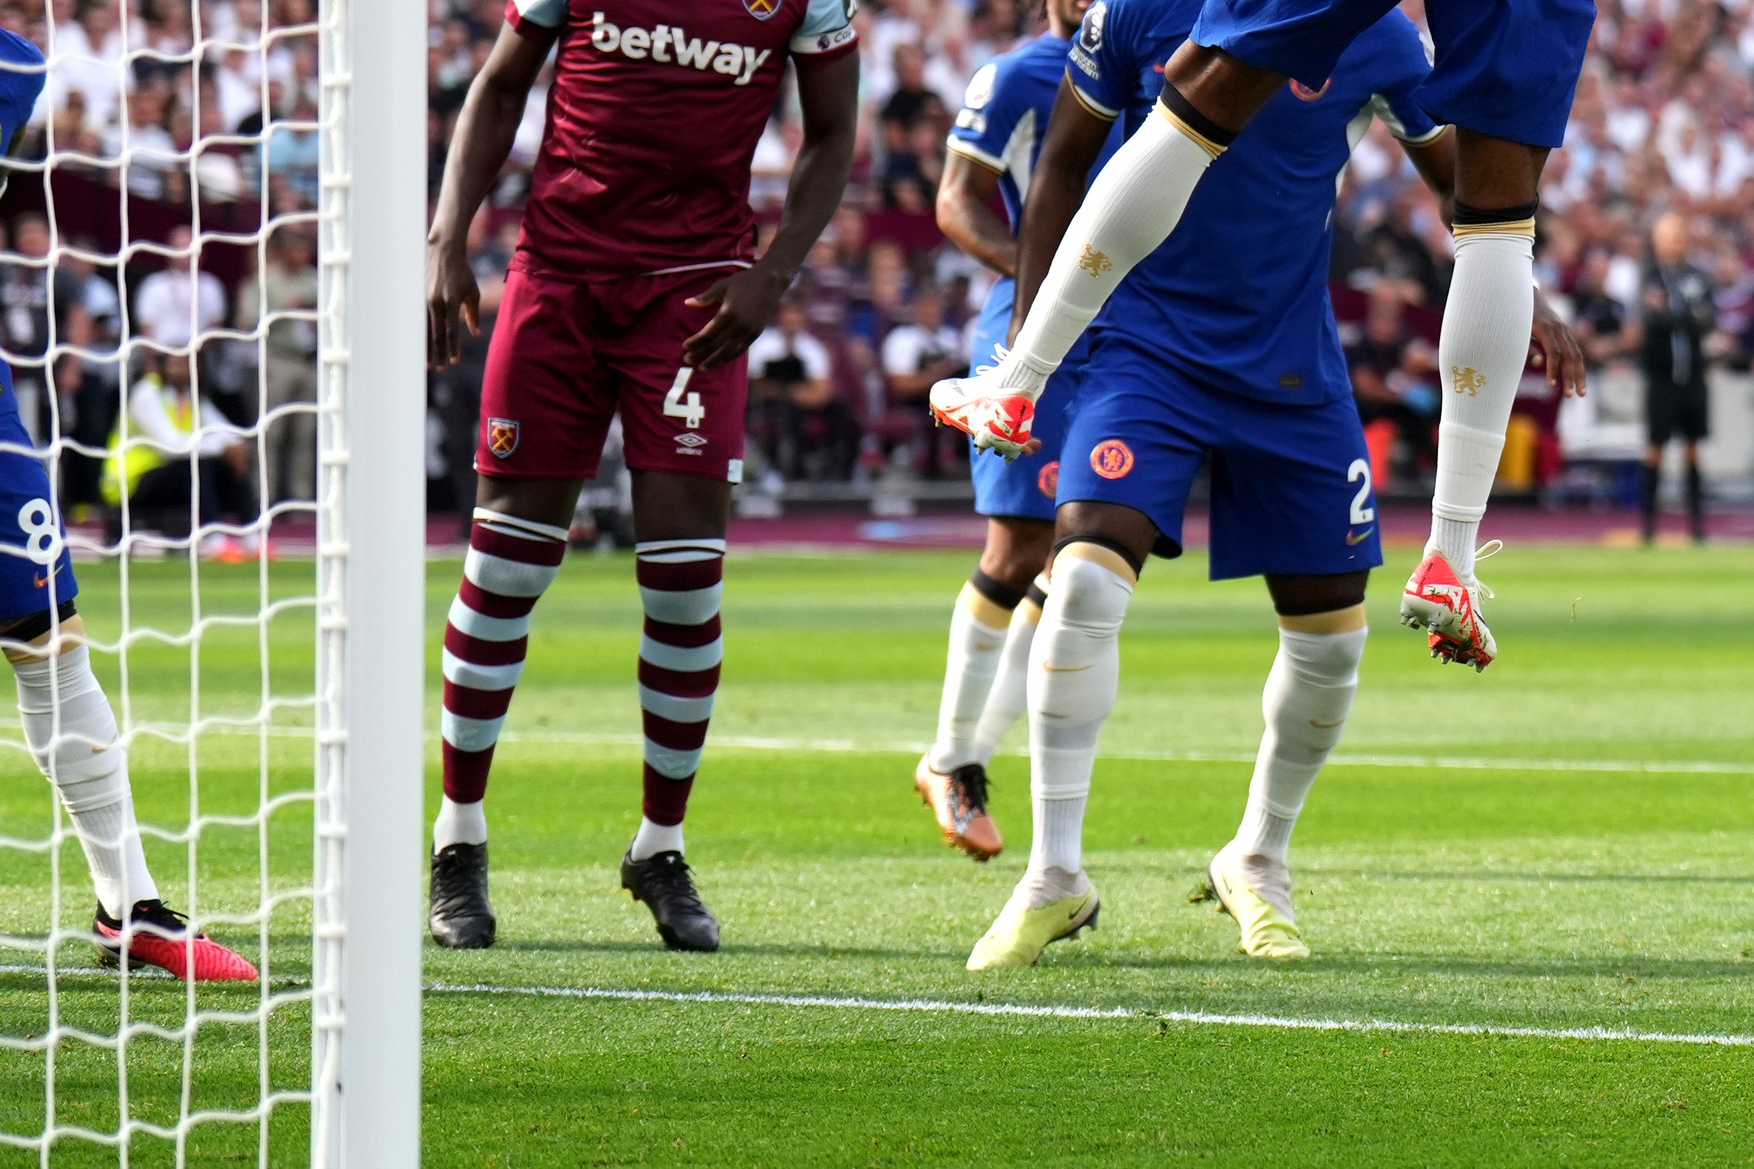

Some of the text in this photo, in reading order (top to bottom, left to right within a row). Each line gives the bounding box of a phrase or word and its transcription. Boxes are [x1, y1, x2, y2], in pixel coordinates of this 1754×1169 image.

[591, 11, 771, 85] betway
[664, 367, 705, 428] 4
[1347, 459, 1375, 525] 2
[18, 498, 63, 564] 8
